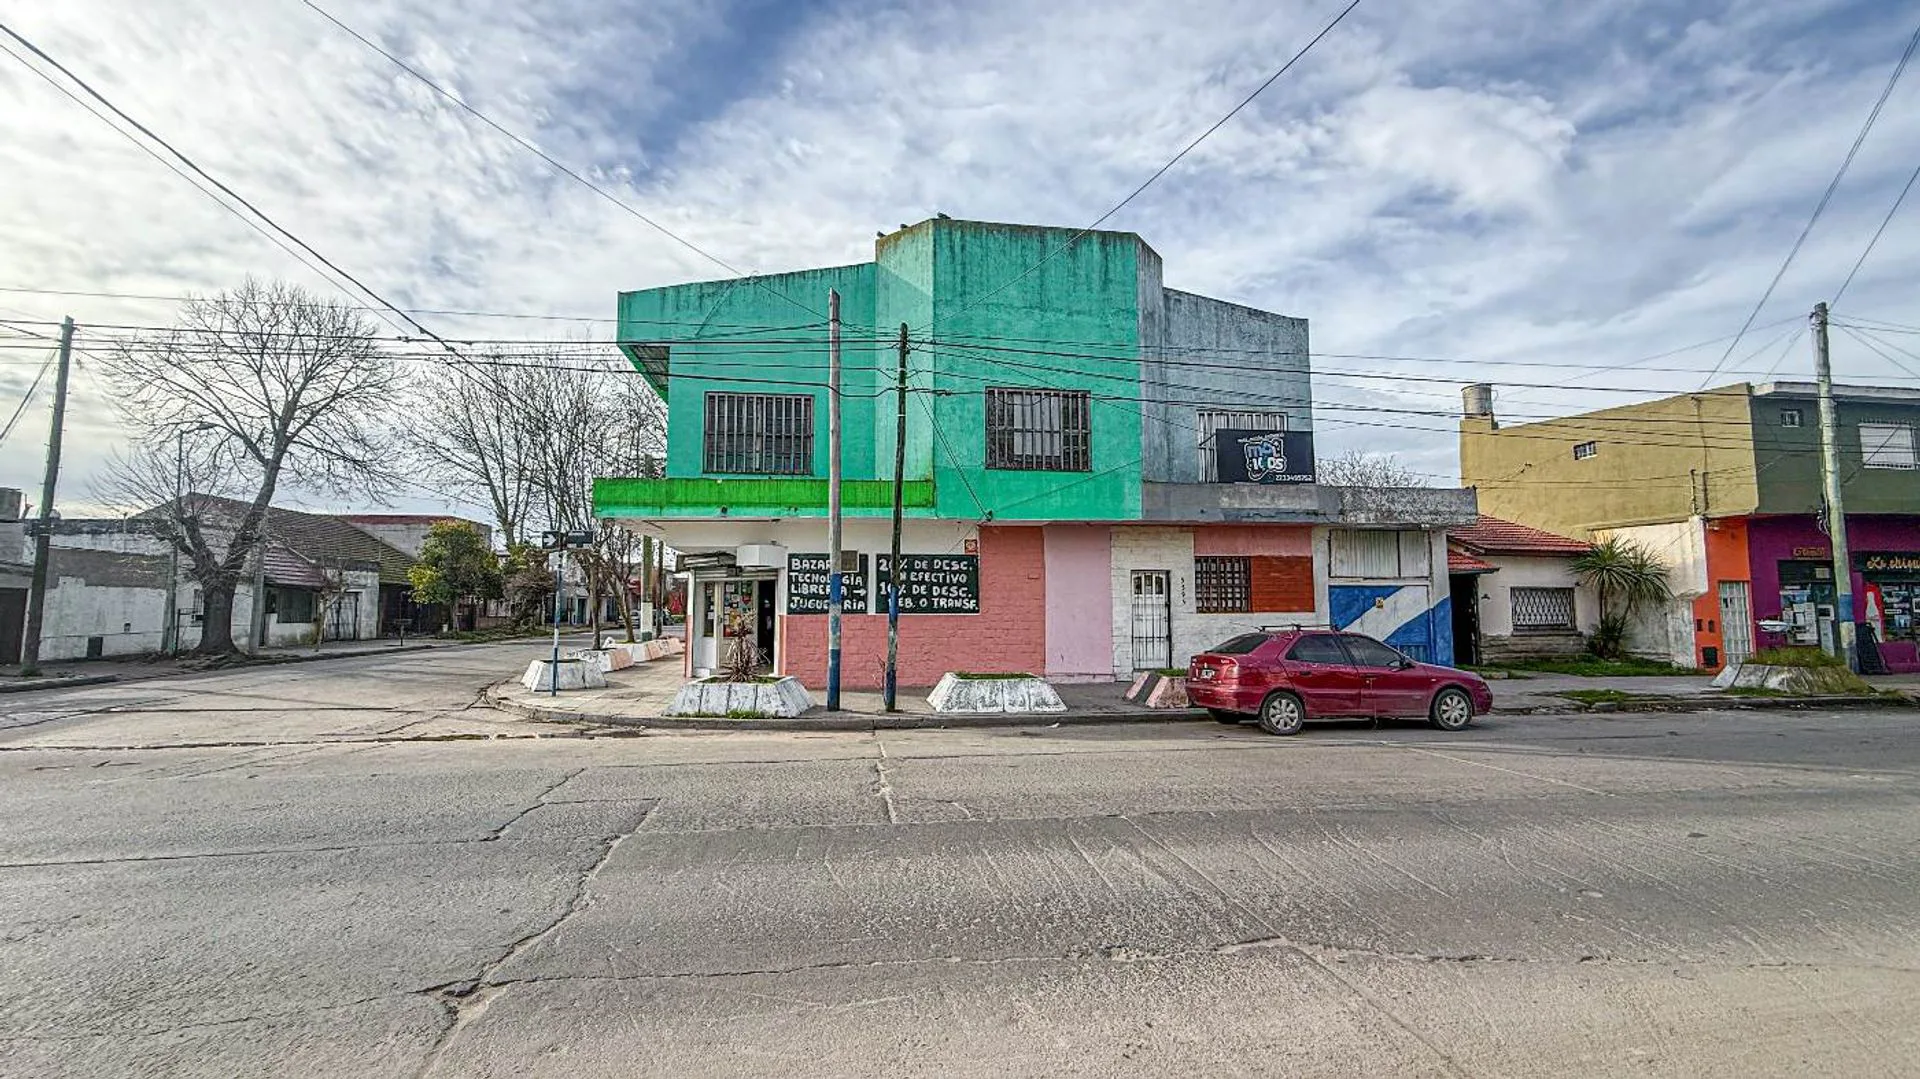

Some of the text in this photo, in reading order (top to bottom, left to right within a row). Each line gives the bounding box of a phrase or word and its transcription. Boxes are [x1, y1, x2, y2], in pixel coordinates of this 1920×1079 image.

[914, 559, 929, 569] DE
[933, 559, 973, 571] DESC.
[912, 584, 927, 595] DE
[932, 585, 972, 597] DESC.
